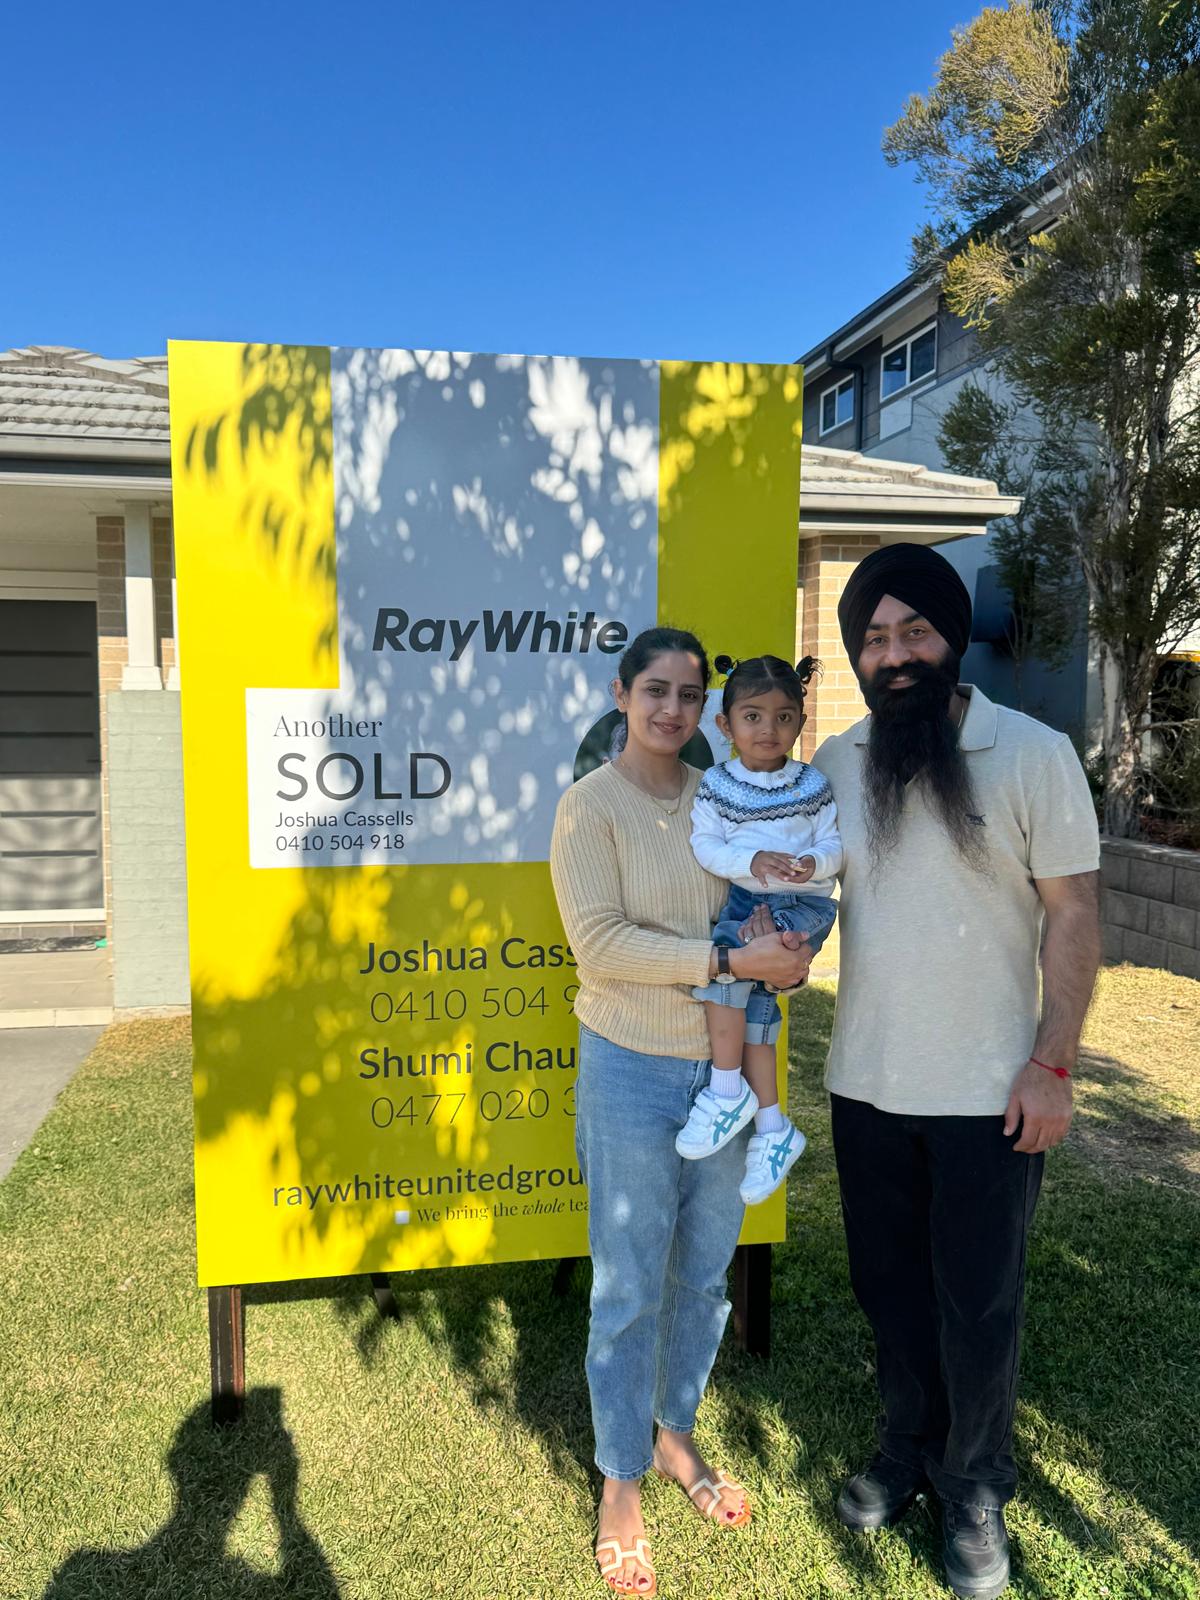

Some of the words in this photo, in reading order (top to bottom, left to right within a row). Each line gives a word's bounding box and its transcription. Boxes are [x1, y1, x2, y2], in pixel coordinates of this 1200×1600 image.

[372, 607, 629, 662] RayWhite
[273, 713, 383, 740] Another
[276, 752, 452, 802] SOLD
[275, 811, 339, 828] Joshua
[343, 809, 414, 828] Cassells
[276, 835, 324, 852] 0410
[330, 834, 365, 851] 504
[370, 833, 405, 850] 918
[360, 940, 488, 974] Joshua
[370, 990, 467, 1023] 0410
[481, 985, 550, 1019] 504
[359, 1043, 473, 1079] Shumi
[485, 1040, 576, 1073] Chau
[371, 1092, 466, 1128] 0477
[480, 1088, 549, 1121] 020
[417, 1207, 441, 1223] We
[445, 1205, 489, 1222] bring
[493, 1202, 518, 1217] the
[522, 1198, 565, 1216] whole
